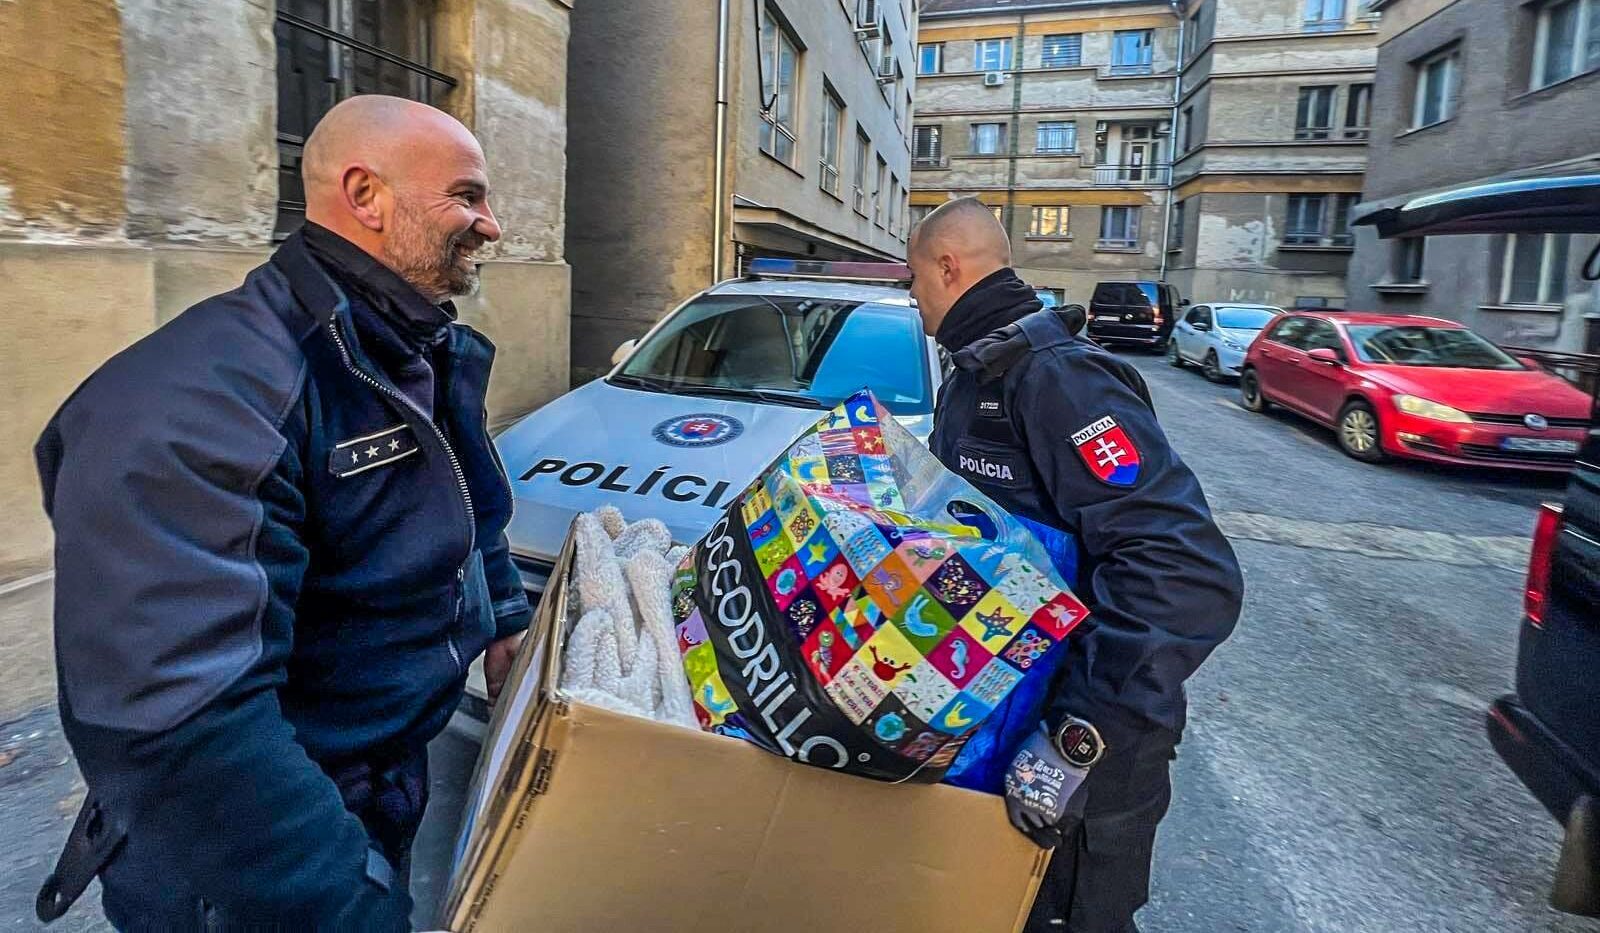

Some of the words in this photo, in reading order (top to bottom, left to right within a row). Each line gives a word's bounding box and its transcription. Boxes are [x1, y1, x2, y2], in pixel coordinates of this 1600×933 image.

[1073, 418, 1115, 444] POLÍCIA
[959, 454, 1014, 481] POLÍCIA
[518, 458, 733, 510] POLÍCI
